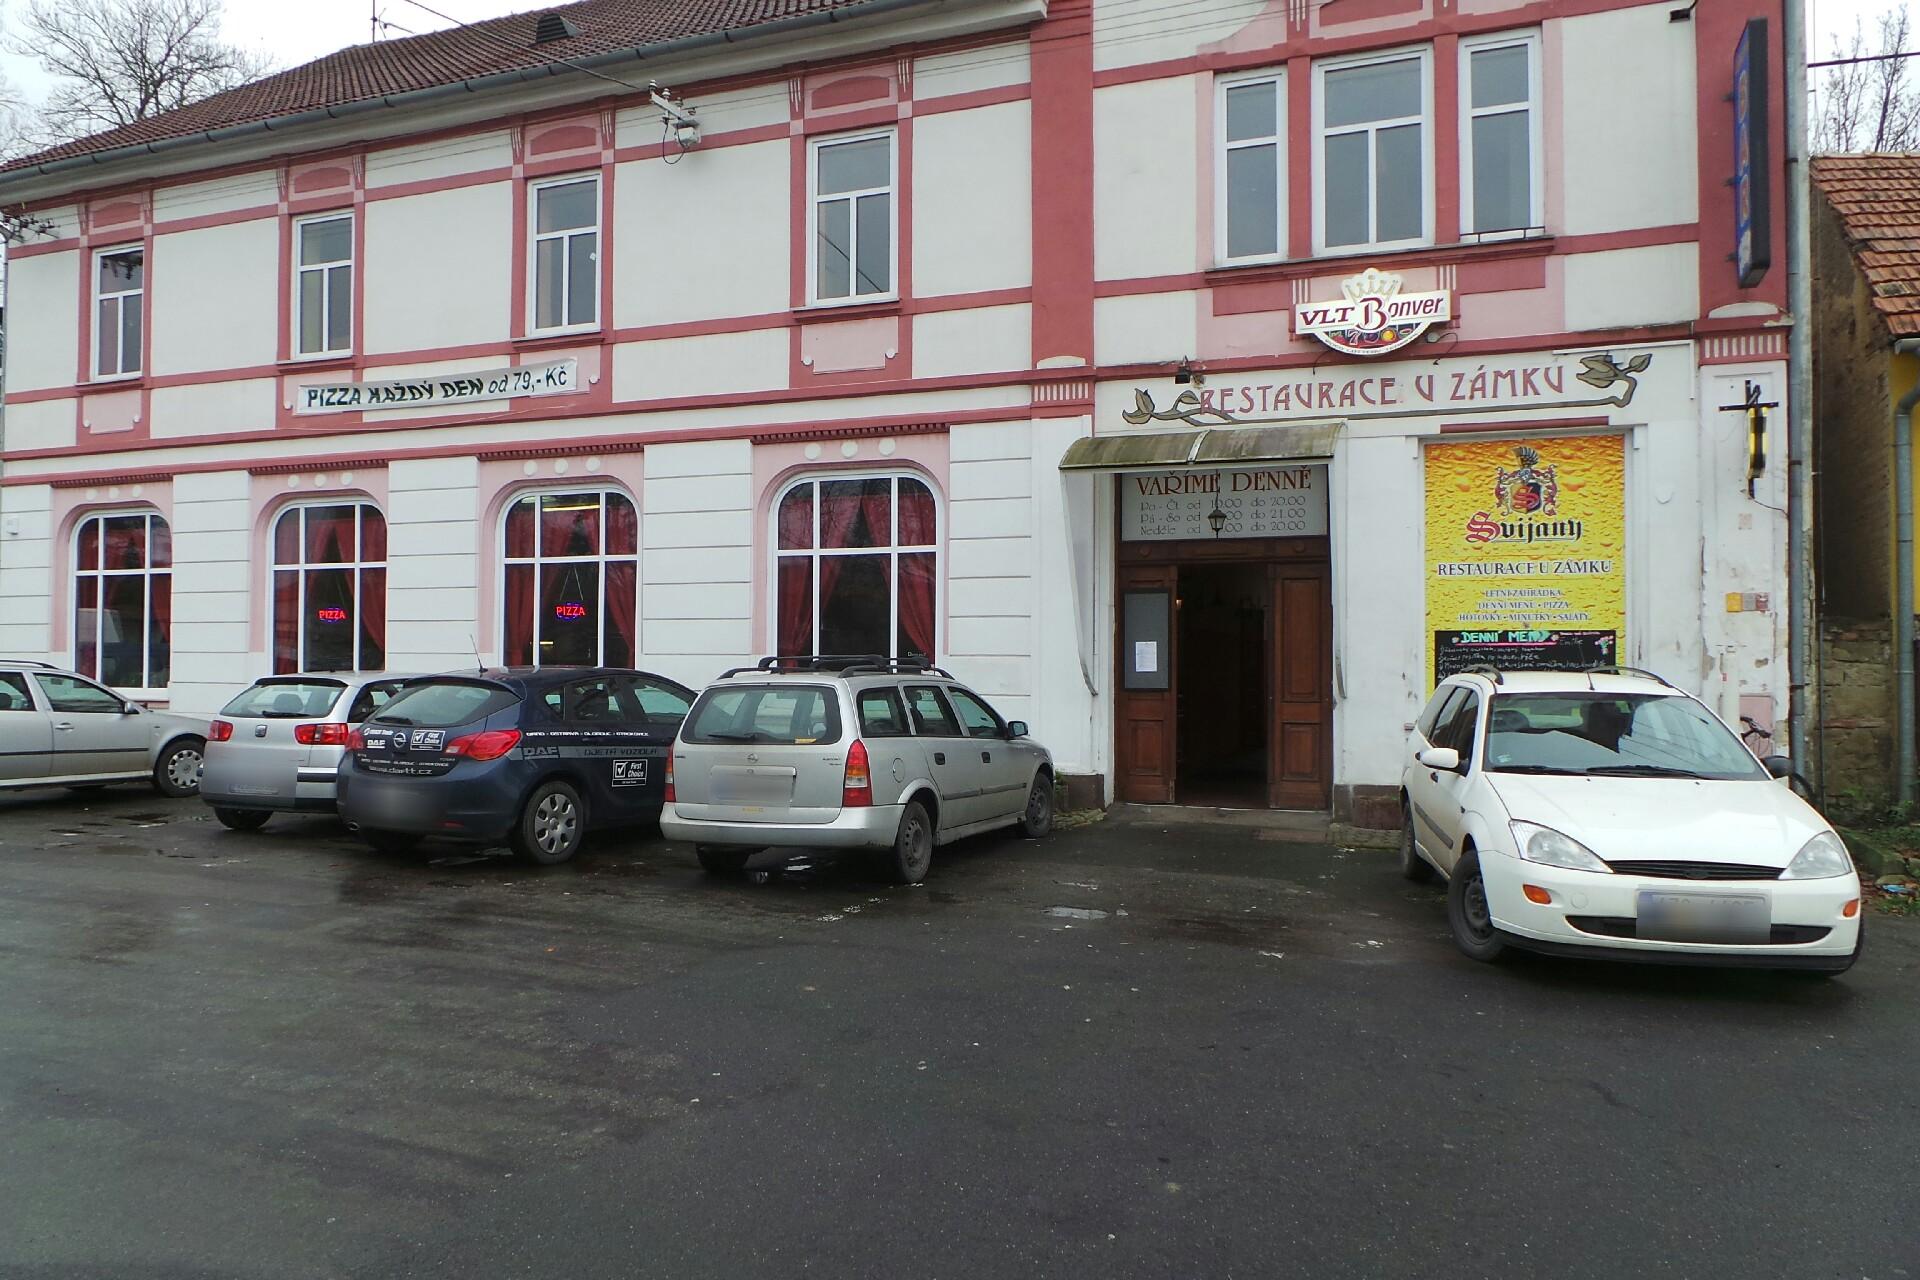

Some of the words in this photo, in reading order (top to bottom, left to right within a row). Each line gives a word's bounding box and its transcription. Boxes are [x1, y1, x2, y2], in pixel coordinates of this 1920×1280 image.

[1300, 307, 1354, 326] VLT
[1356, 297, 1443, 330] Bonver
[308, 386, 361, 407] PIZZA
[443, 378, 484, 398] DEN
[488, 372, 507, 394] od
[546, 366, 567, 387] Kč
[1201, 376, 1399, 416] RESTAURACE
[1415, 374, 1435, 402] U
[1452, 365, 1563, 400] ZÁMKU
[1232, 466, 1312, 491] DENNĚ
[1251, 497, 1265, 507] do
[1270, 496, 1306, 507] 20.00
[1251, 510, 1265, 519] do
[1251, 522, 1265, 531] do
[1466, 511, 1581, 543] Svijany
[1438, 562, 1535, 576] RESTAURACE
[1539, 561, 1550, 574] U
[1554, 559, 1612, 574] ZÁMKU
[1543, 601, 1569, 609] PIZZA
[319, 610, 346, 620] PIZZA
[556, 606, 586, 616] PIZZA
[524, 747, 557, 755] DAF
